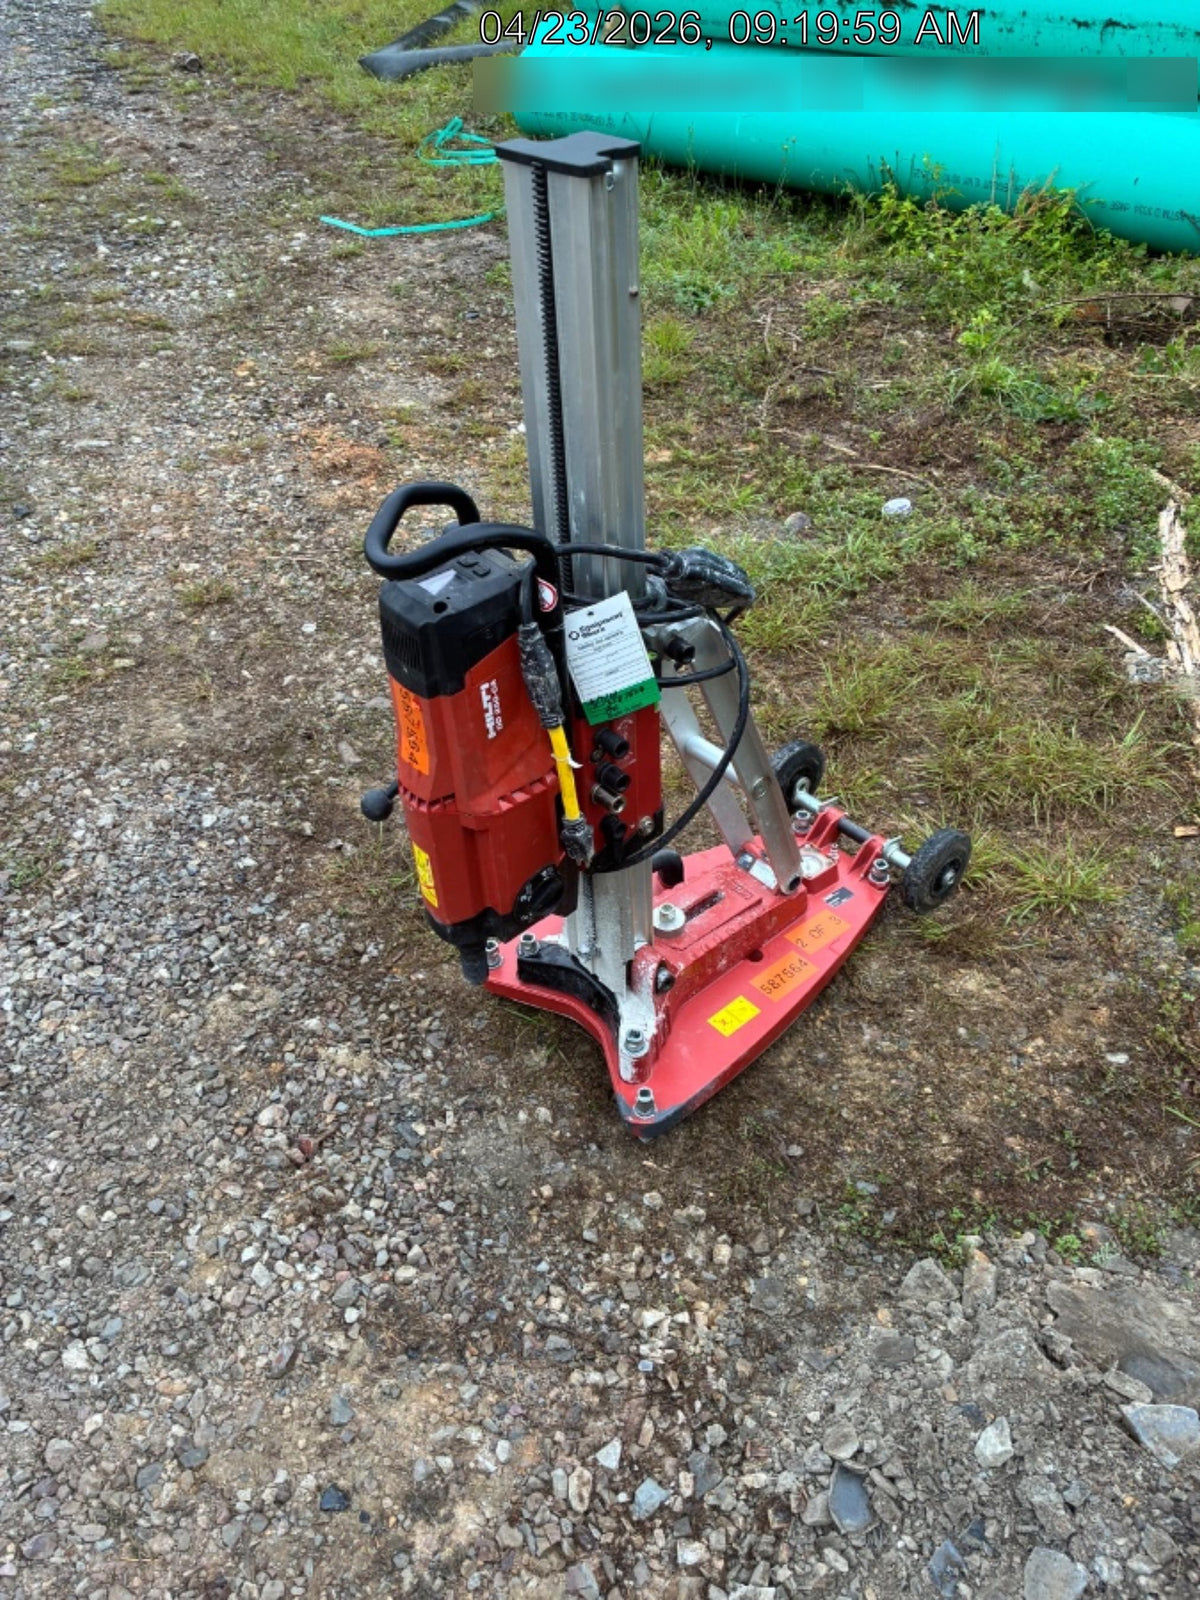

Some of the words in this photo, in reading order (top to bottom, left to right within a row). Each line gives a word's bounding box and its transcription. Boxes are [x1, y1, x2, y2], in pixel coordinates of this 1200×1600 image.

[480, 682, 497, 739] HILTI
[795, 938, 808, 948] 2
[808, 924, 825, 939] OF
[829, 915, 842, 925] 3
